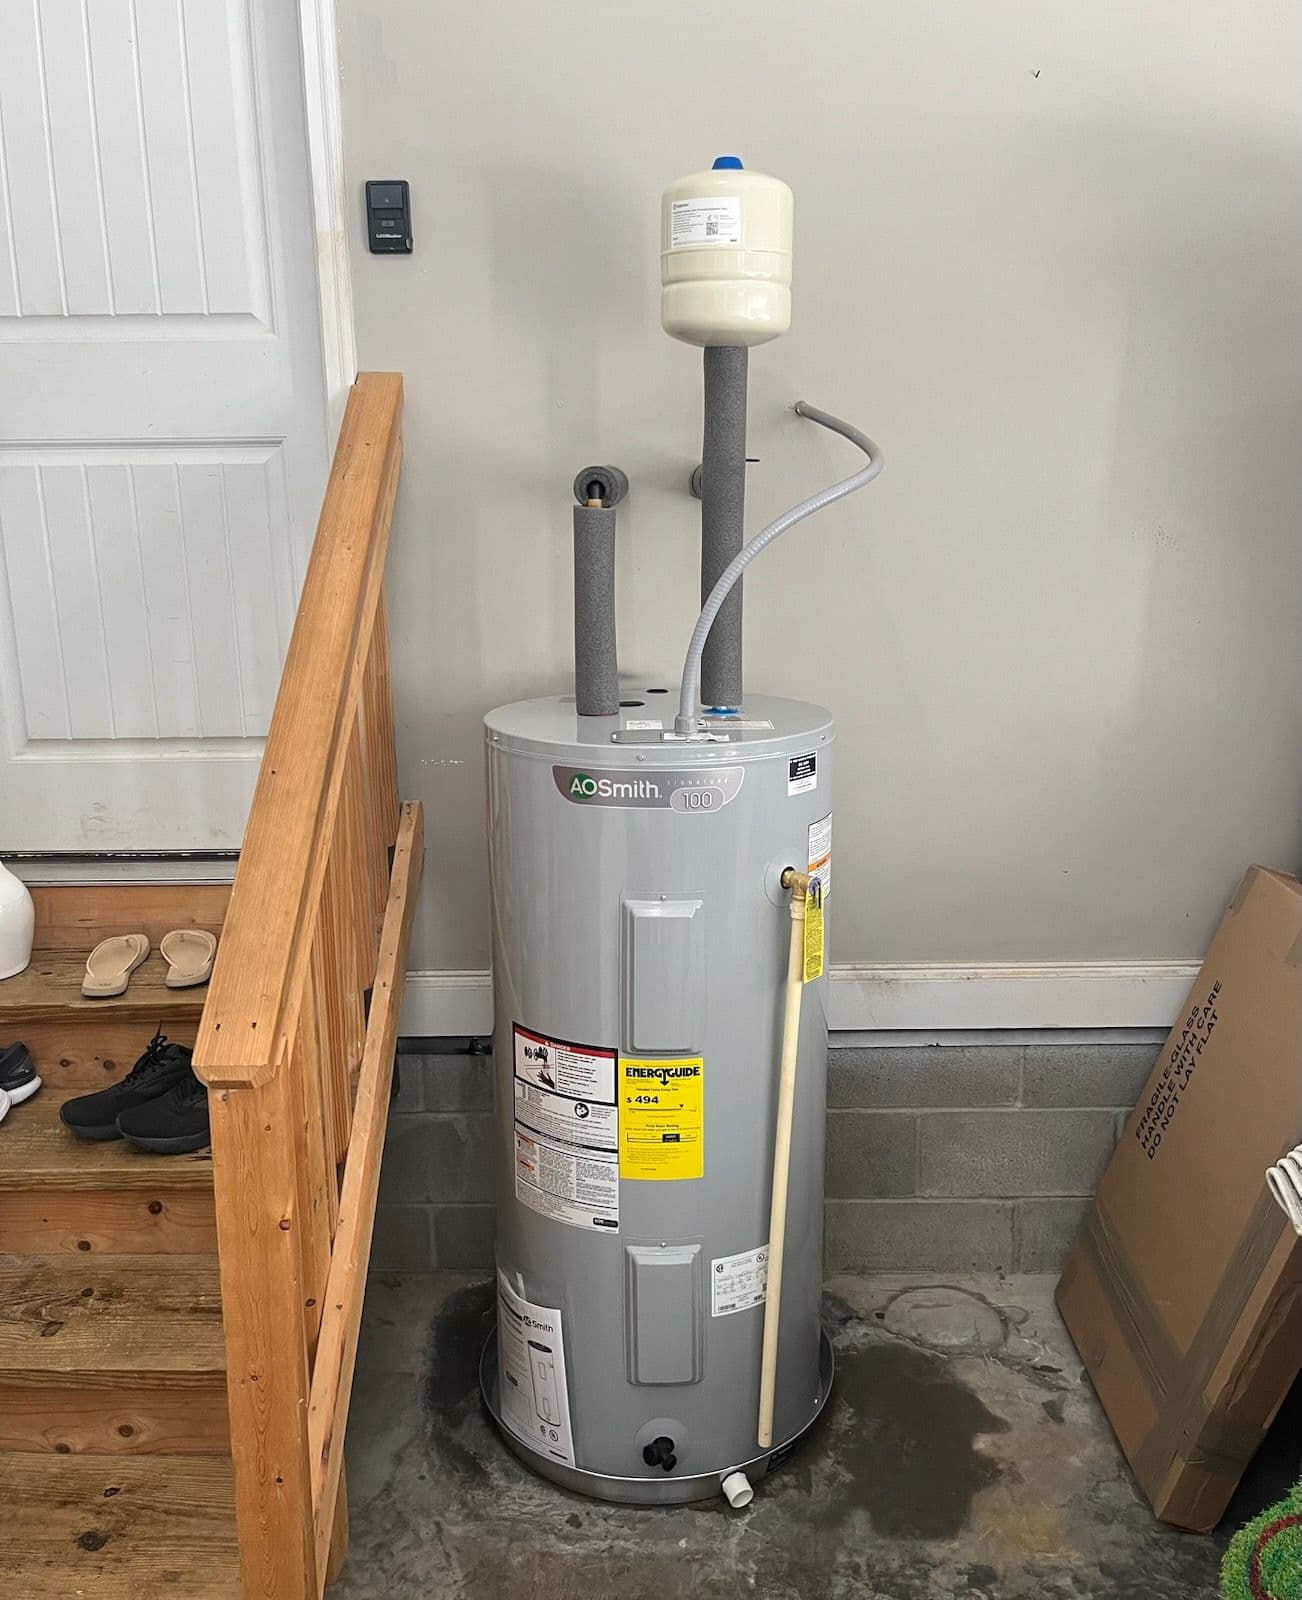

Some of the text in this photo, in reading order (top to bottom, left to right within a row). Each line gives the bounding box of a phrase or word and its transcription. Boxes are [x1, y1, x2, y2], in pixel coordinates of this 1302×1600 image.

[683, 791, 713, 809] 100
[635, 1095, 659, 1104] 494
[1136, 1005, 1200, 1140] FRAGILE-GLASS
[1141, 979, 1223, 1150] HANDLE WITH CARE
[1147, 1009, 1218, 1160] DO NOT LAY FLAT
